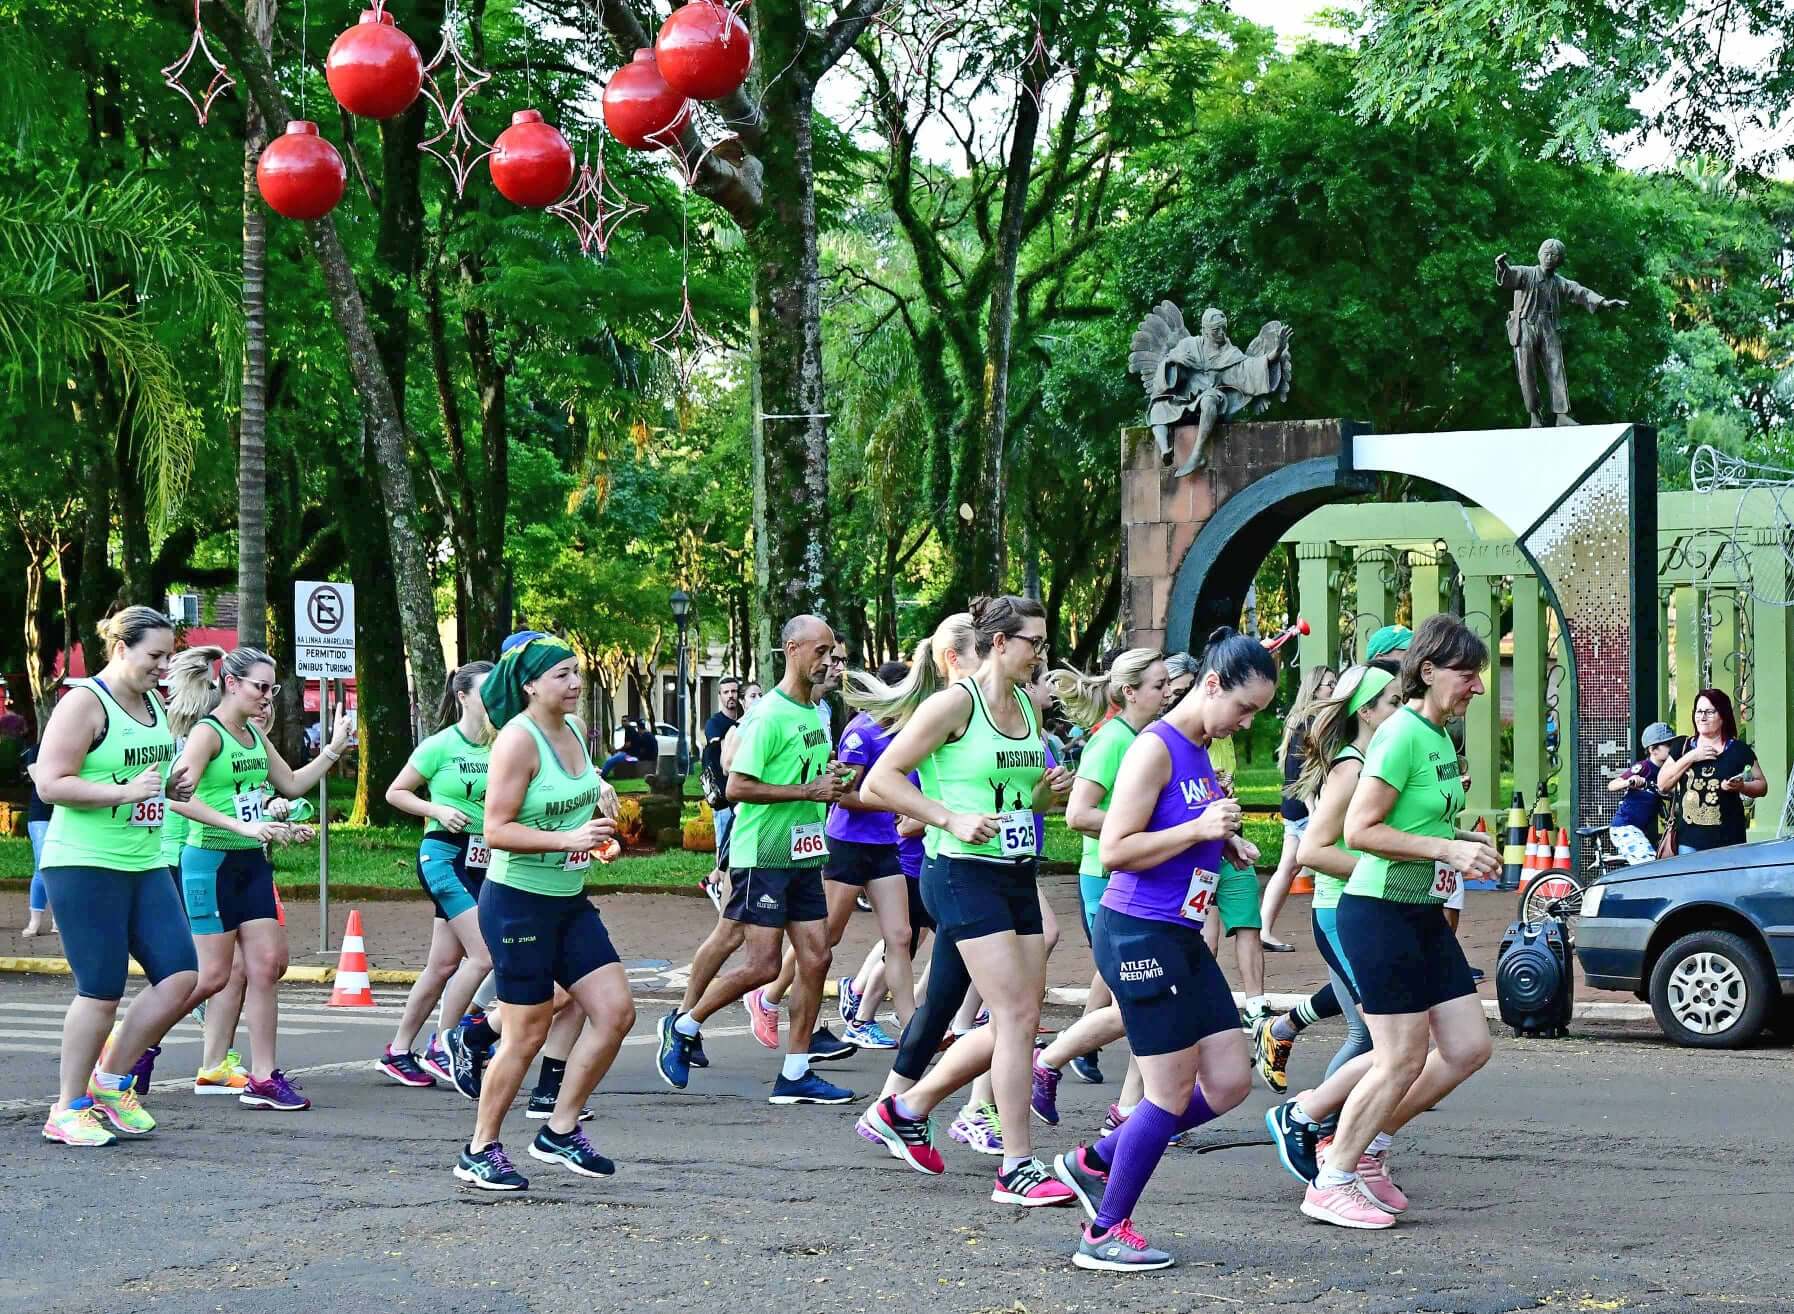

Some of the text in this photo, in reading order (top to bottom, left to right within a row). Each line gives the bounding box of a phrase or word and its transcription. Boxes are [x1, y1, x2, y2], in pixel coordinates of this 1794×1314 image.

[306, 636, 322, 644] LINHA
[305, 649, 347, 659] PERMITIDO
[298, 660, 353, 673] ÔNIBUS TURISMO
[135, 803, 164, 822] 365
[794, 835, 823, 854] 466
[1006, 826, 1035, 849] 525
[1120, 958, 1160, 972] ATLETA
